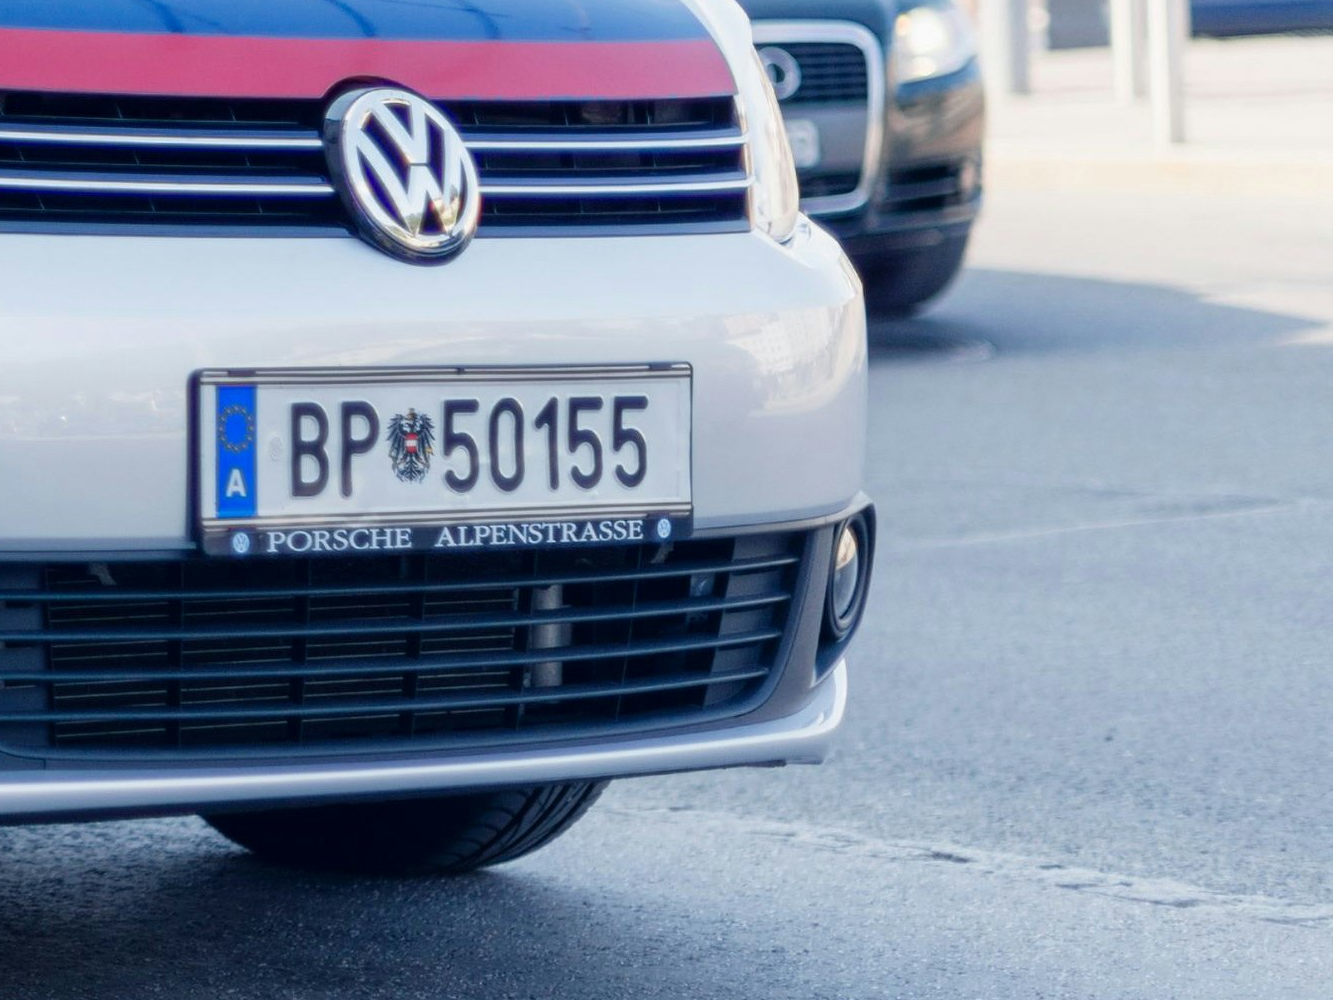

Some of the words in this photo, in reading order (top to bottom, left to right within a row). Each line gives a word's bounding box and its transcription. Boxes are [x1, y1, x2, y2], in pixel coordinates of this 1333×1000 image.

[290, 400, 380, 498] BP
[441, 396, 649, 493] 50155
[225, 468, 247, 497] A
[266, 527, 412, 553] PORSCHE
[434, 520, 644, 548] ALPENSTRASSE
